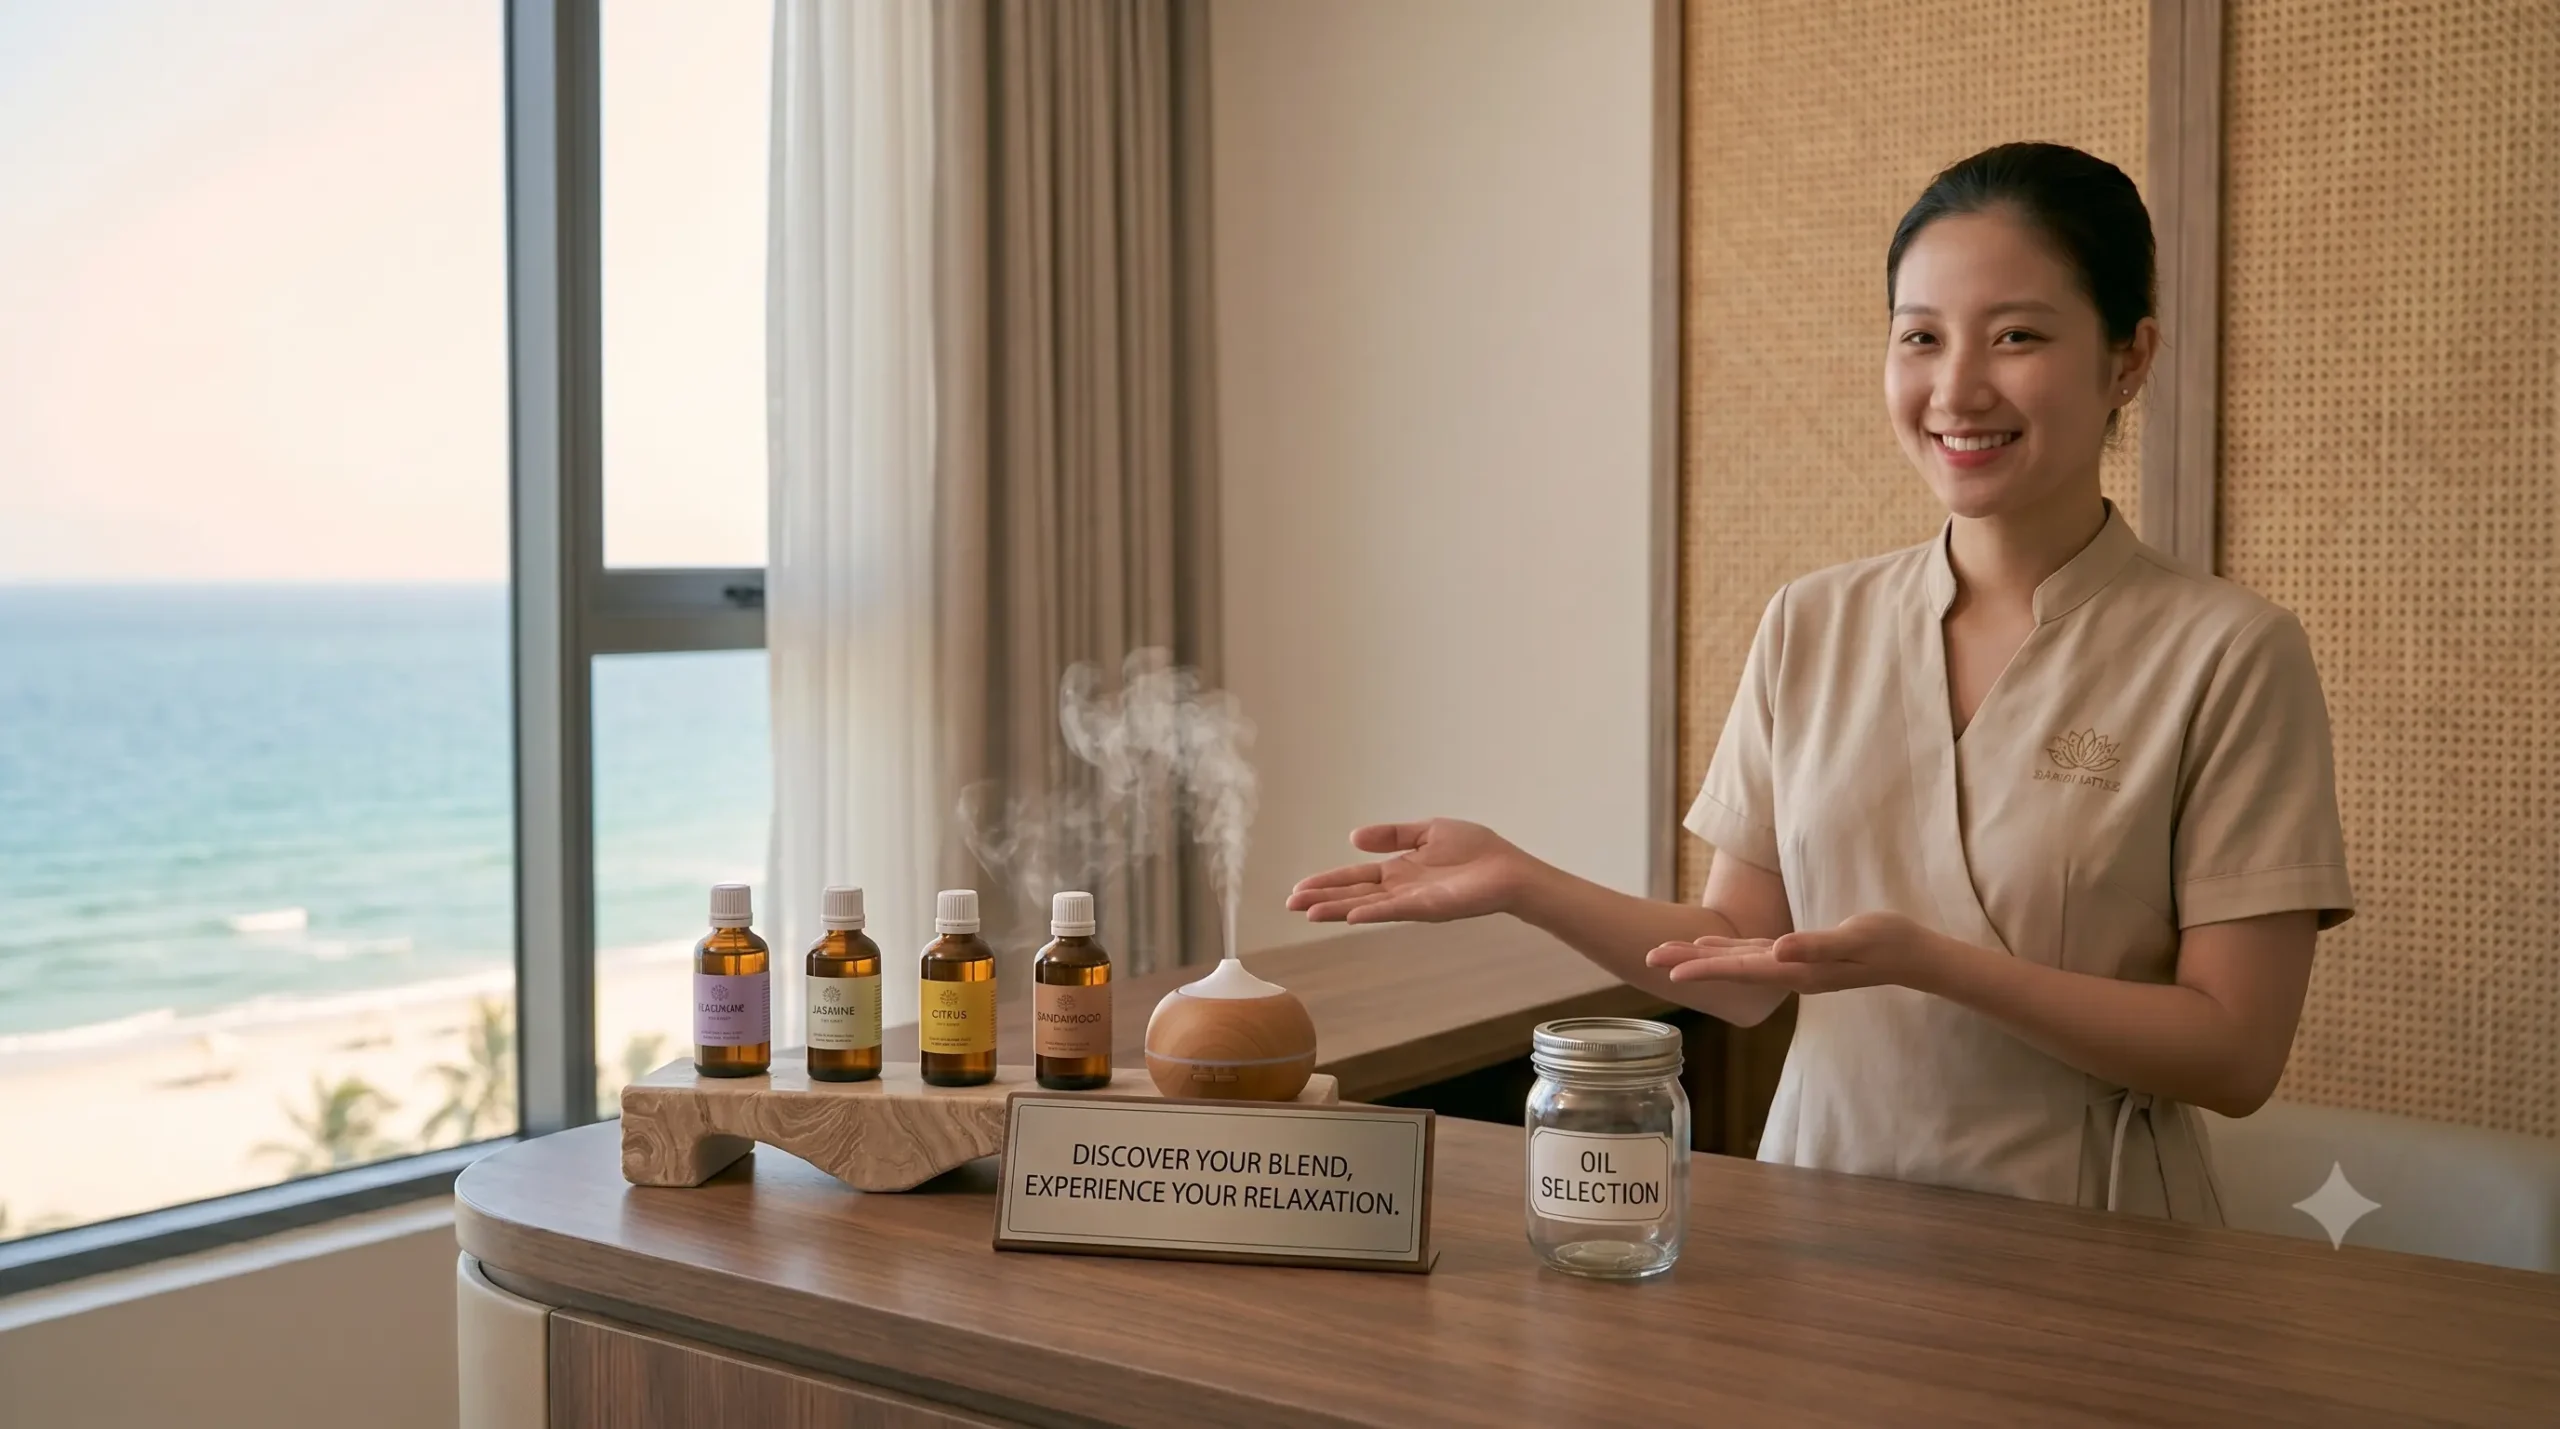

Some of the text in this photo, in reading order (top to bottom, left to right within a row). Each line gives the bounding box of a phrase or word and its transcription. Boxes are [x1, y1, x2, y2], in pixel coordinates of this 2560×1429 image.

[931, 1009, 968, 1020] CITRUS
[1073, 1144, 1353, 1182] DISCOVER YOUR BLEND,
[1581, 1150, 1617, 1174] OIL
[1025, 1174, 1400, 1216] EXPERIENCE YOUR RELAXATION.
[1541, 1175, 1659, 1205] SELECTION
